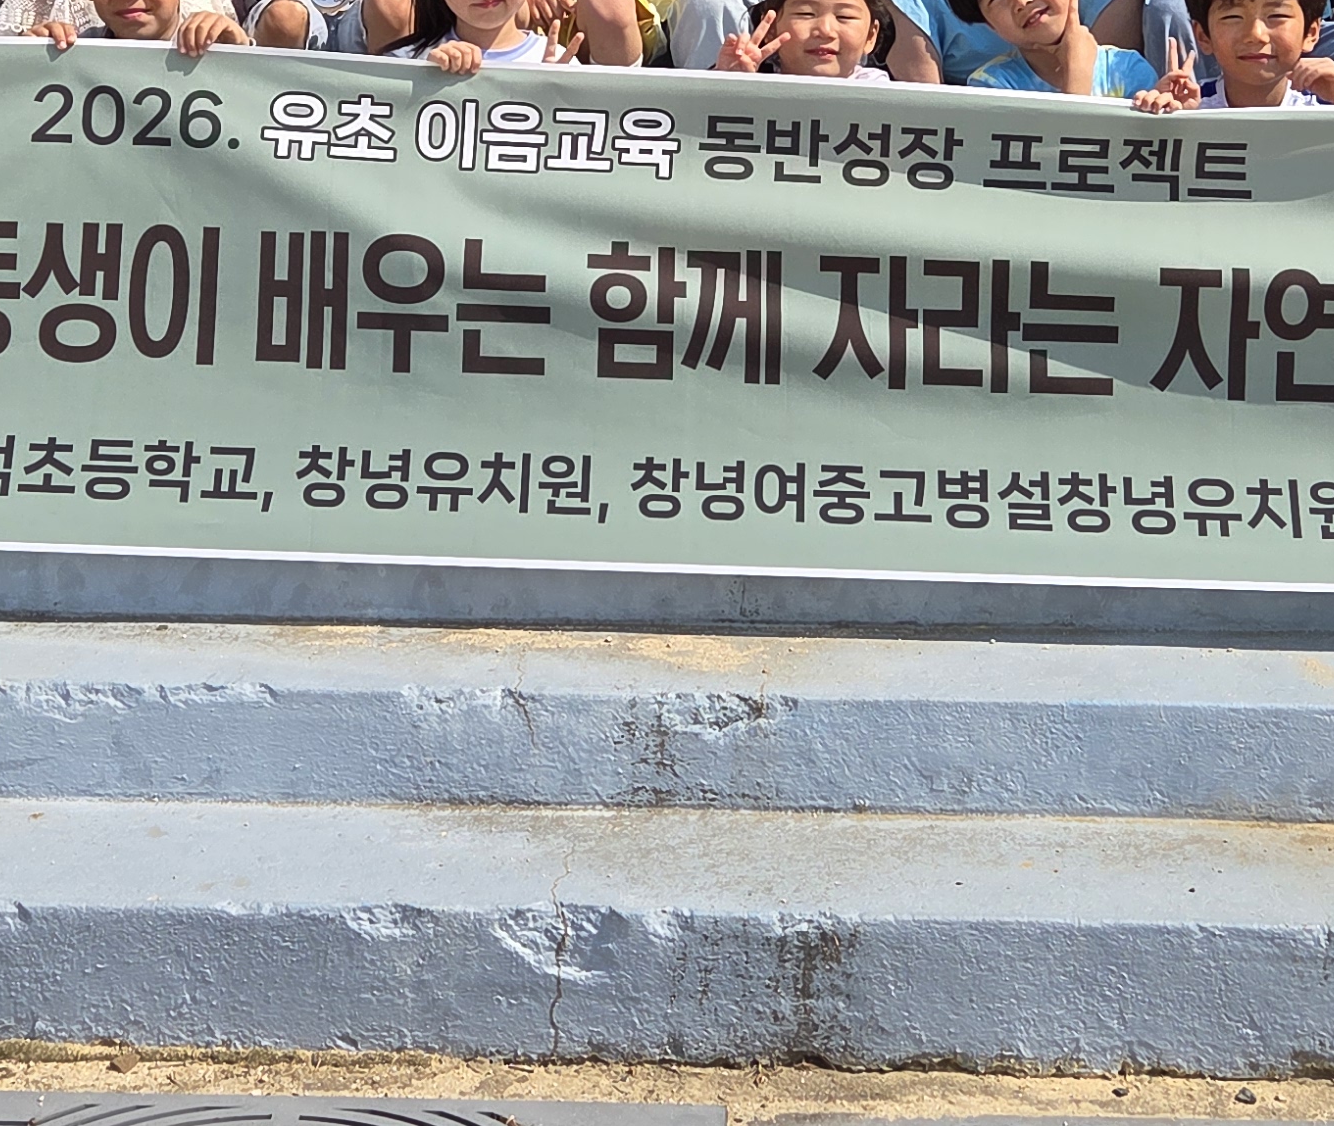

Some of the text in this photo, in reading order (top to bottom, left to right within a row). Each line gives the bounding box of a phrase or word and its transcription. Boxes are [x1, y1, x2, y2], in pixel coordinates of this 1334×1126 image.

[30, 83, 1253, 202] 2026. 유초 이음교육 동반성장 프로젝트
[255, 230, 552, 376] 배우는
[587, 240, 783, 386] 함께
[811, 254, 1120, 397] 자라는
[295, 444, 609, 524] 창녕유치원,
